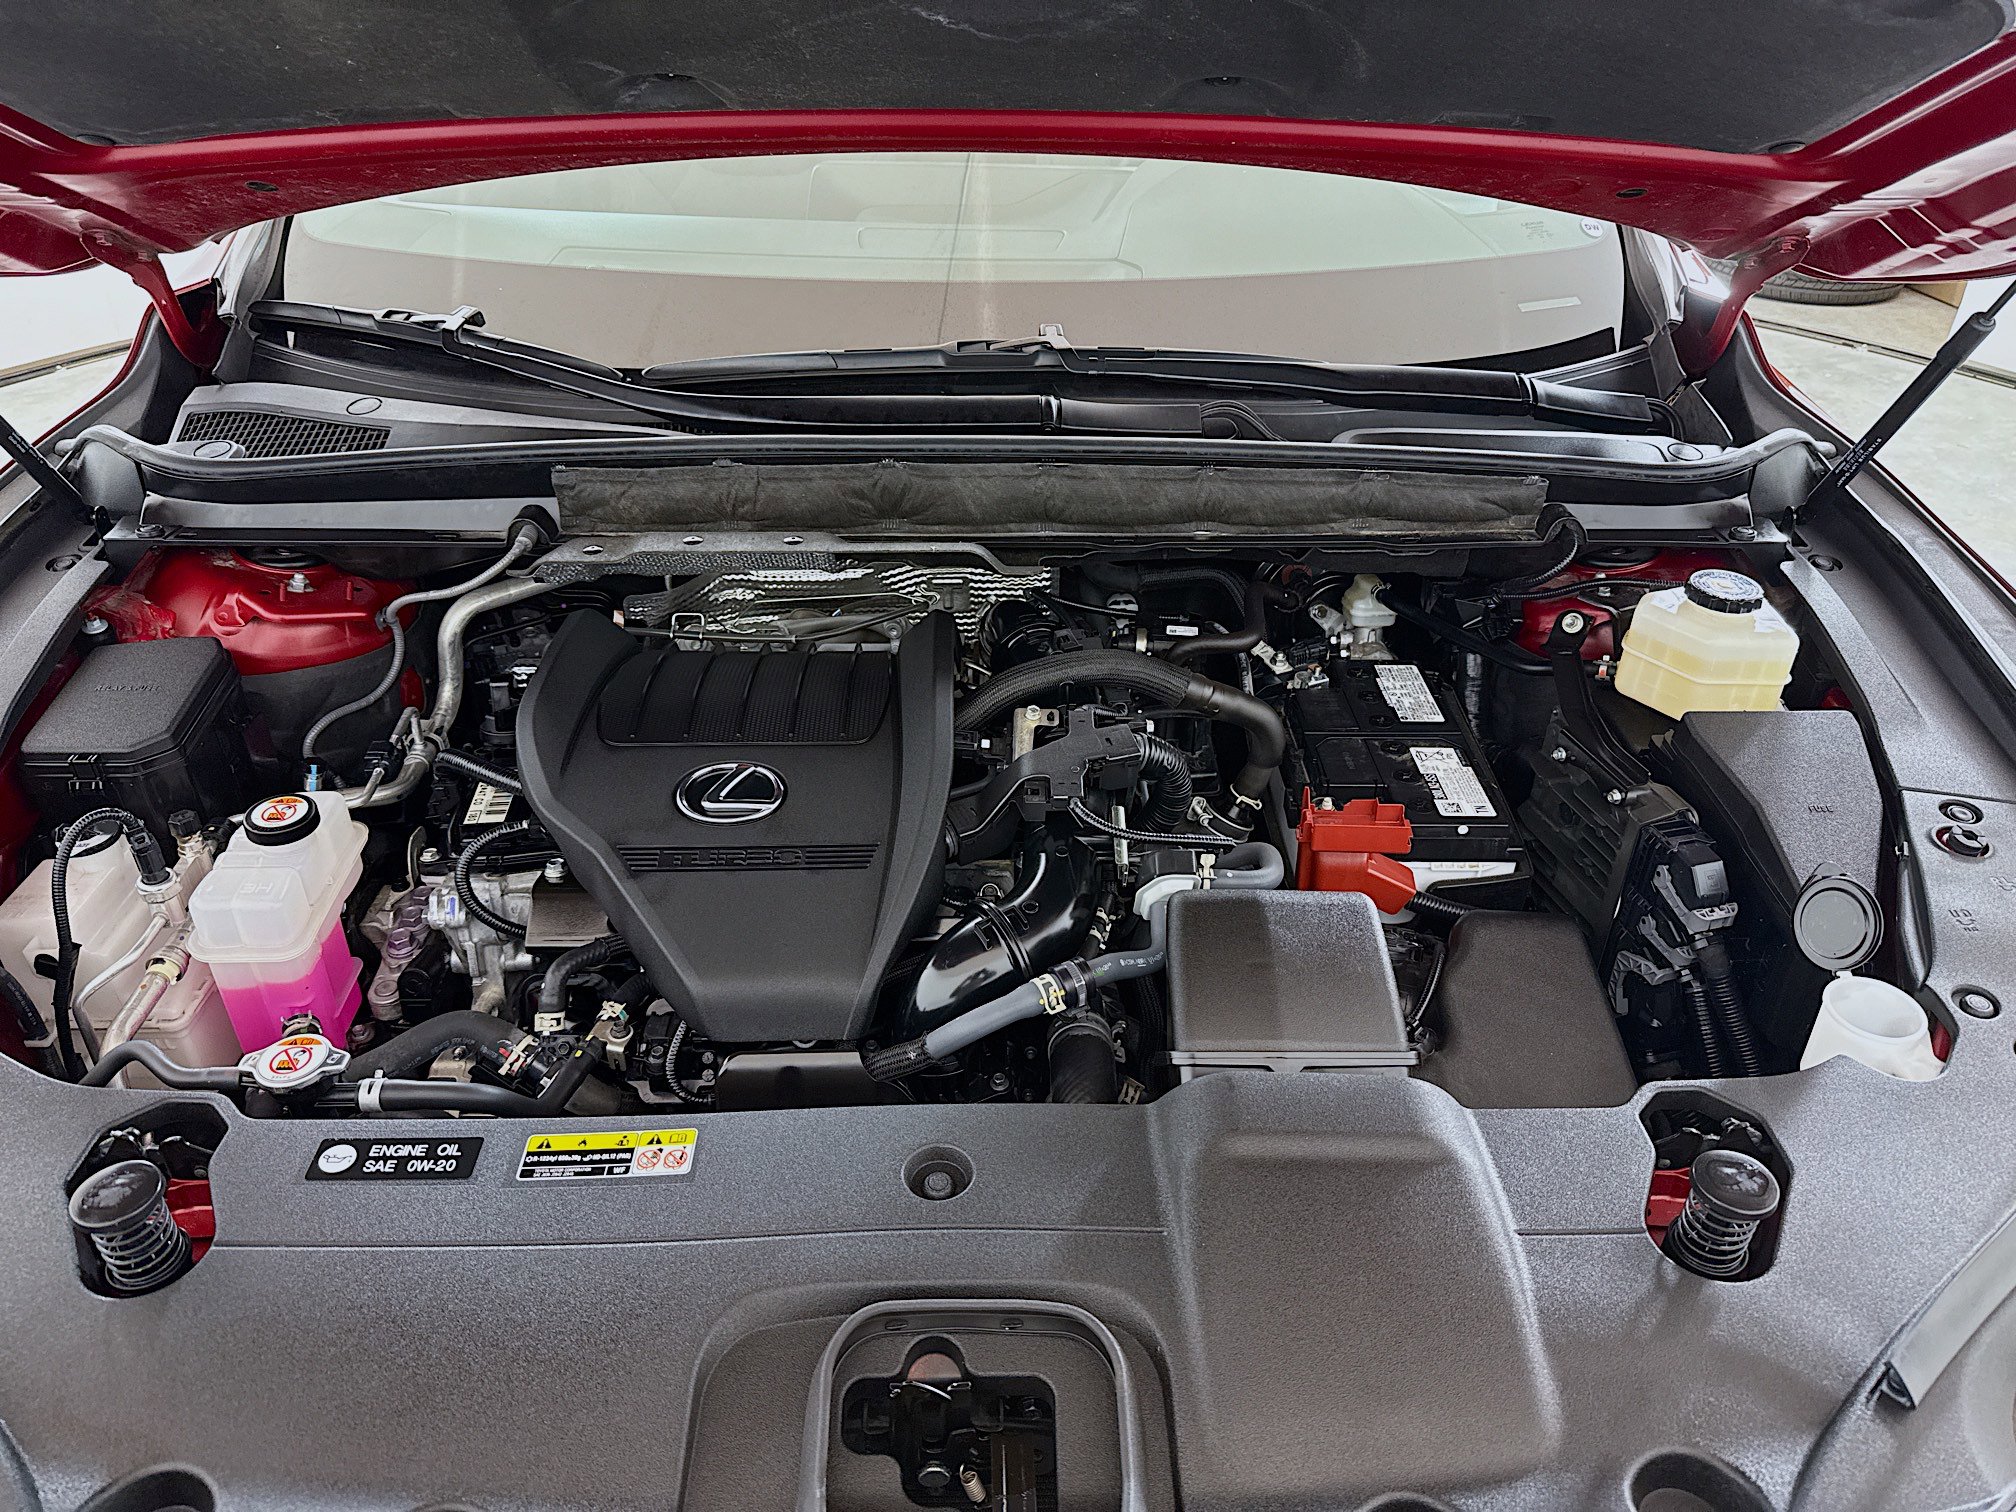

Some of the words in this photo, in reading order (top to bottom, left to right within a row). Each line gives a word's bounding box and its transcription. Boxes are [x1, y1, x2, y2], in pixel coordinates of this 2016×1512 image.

[663, 849, 802, 866] TURBO
[369, 1144, 429, 1157] ENGINE
[437, 1144, 462, 1156] OIL
[362, 1160, 398, 1172] SAE
[406, 1159, 457, 1172] 0W-20
[613, 1166, 627, 1174] WF
